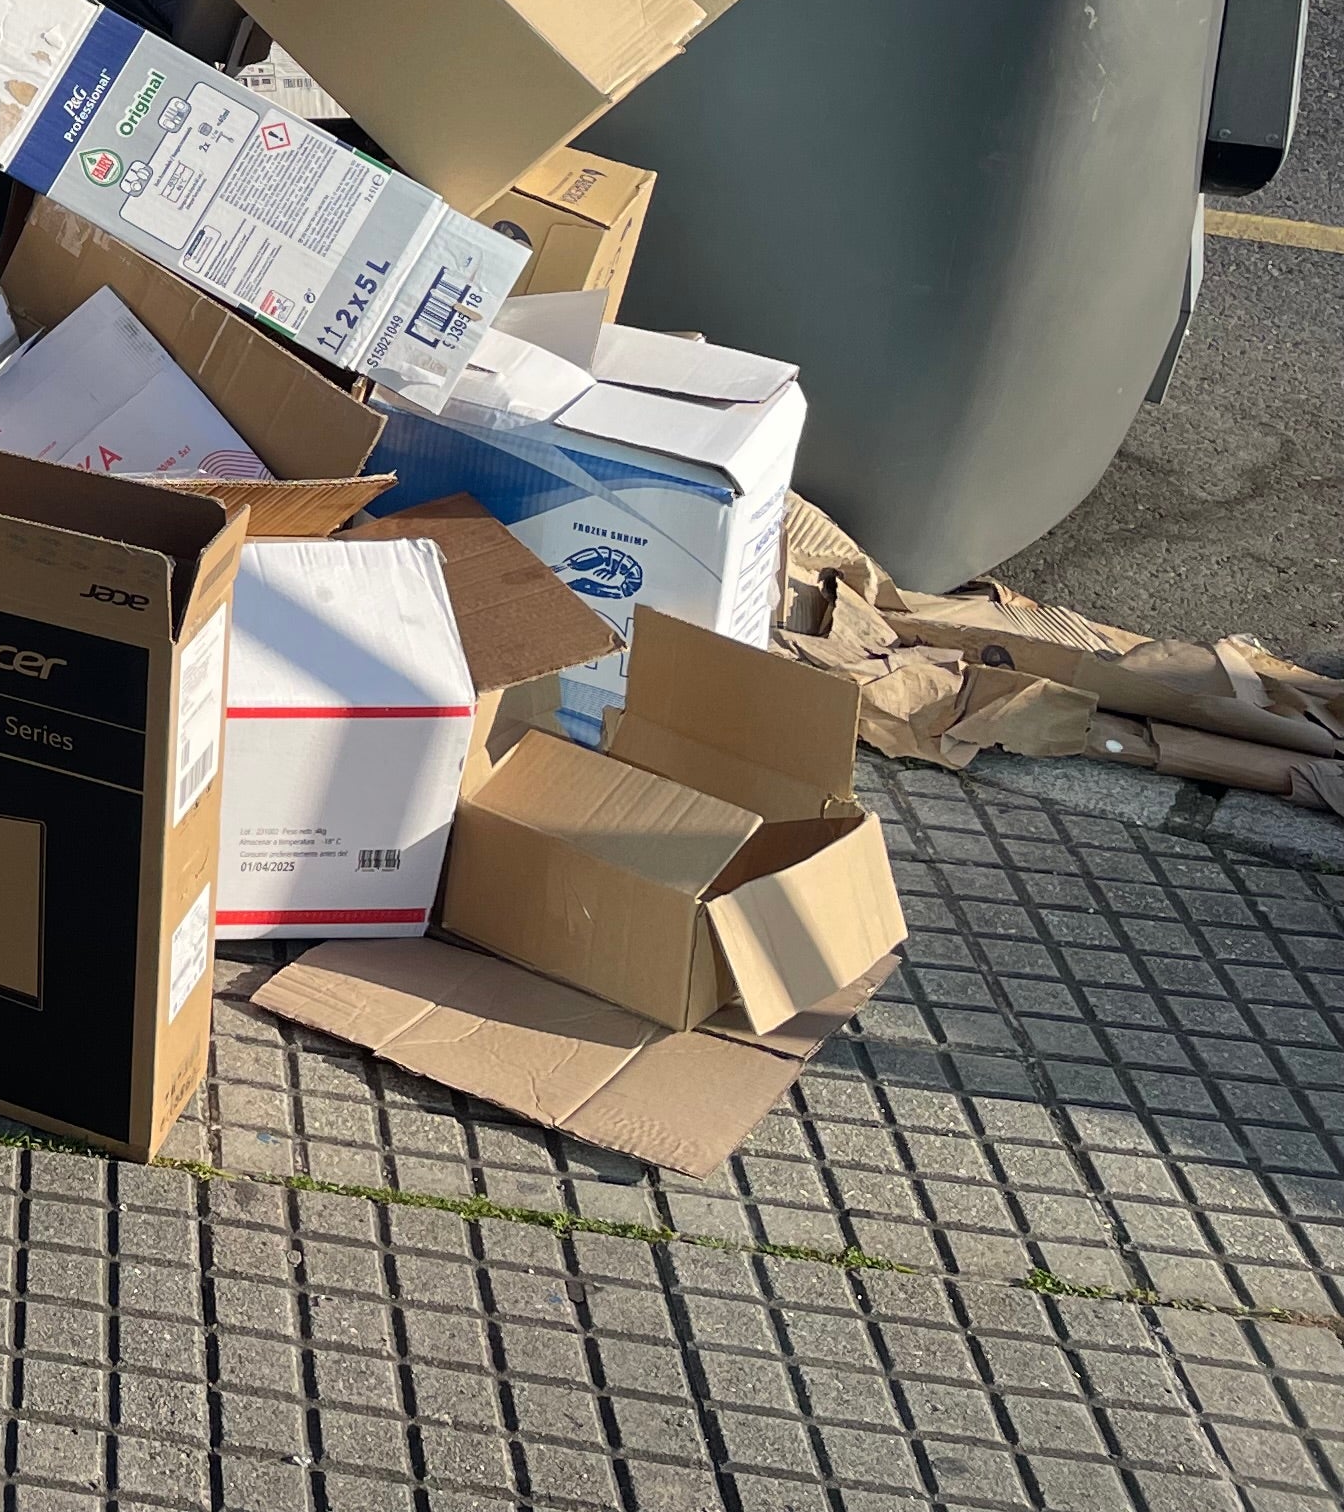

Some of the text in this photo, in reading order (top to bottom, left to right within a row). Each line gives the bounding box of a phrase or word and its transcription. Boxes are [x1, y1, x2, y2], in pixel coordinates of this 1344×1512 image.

[63, 84, 88, 117] P&G
[64, 73, 112, 143] Professional
[118, 71, 166, 137] Original
[91, 153, 114, 181] FAIRY
[367, 315, 404, 368] S15021049
[572, 522, 648, 547] FROZEN SHRIMP
[79, 584, 150, 612] acer
[4, 716, 73, 751] Series
[240, 862, 295, 872] 01/04/2025
